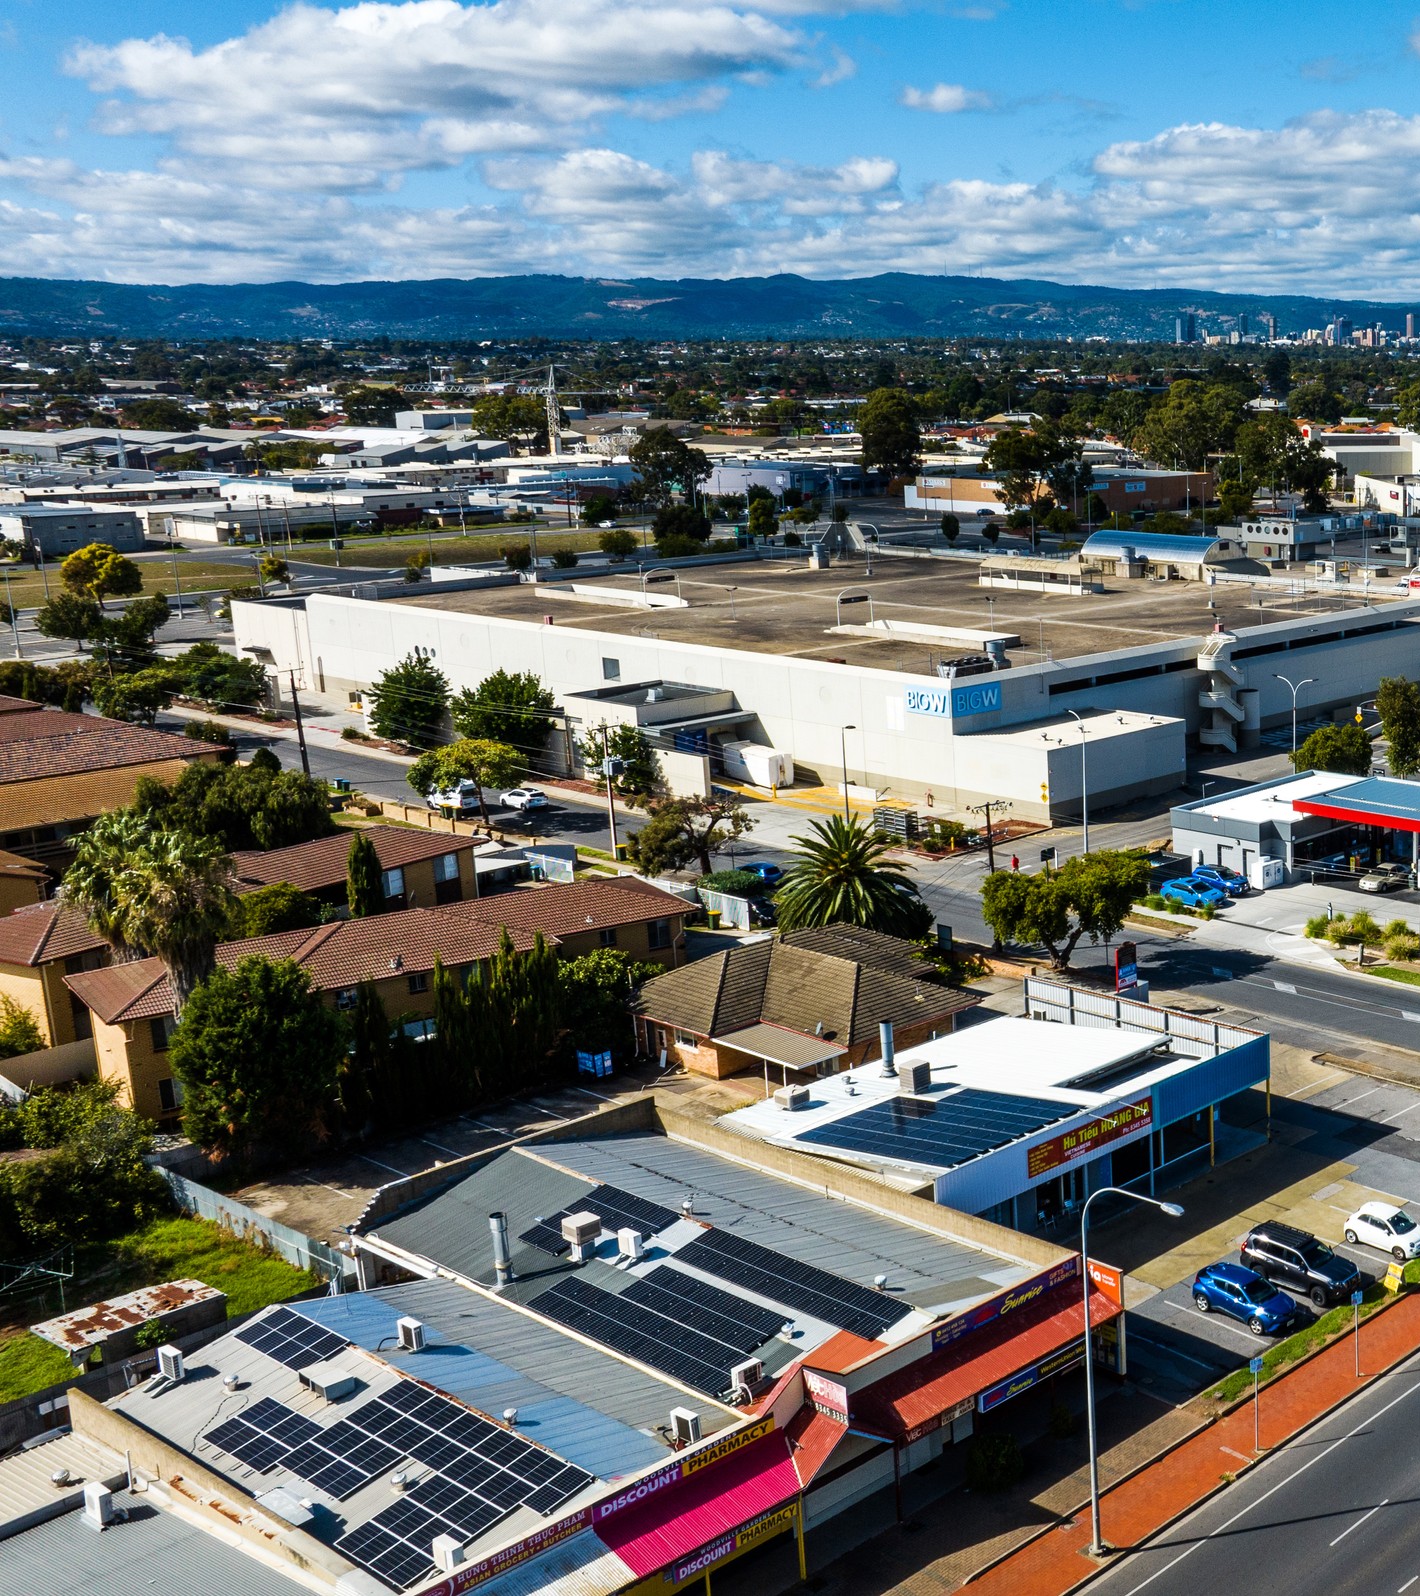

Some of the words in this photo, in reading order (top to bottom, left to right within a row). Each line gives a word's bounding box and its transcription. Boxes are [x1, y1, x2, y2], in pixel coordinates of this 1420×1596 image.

[1087, 1264, 1102, 1282] ia
[1000, 1284, 1044, 1316] Sunrise
[600, 1468, 680, 1518] DISCOUNT
[687, 1423, 769, 1473] PHARMACY
[634, 1455, 690, 1488] WOODVILLE
[694, 1432, 738, 1457] GARDENS
[464, 1570, 491, 1590] ASIAN
[493, 1546, 535, 1574] GROCERY
[543, 1522, 582, 1548] BUTCHER
[678, 1541, 732, 1580] DISCOUNT
[740, 1505, 796, 1545] PHARMACY
[699, 1530, 740, 1556] WOODVILLE
[741, 1511, 772, 1532] GARDENS
[457, 1561, 488, 1584] HUNG
